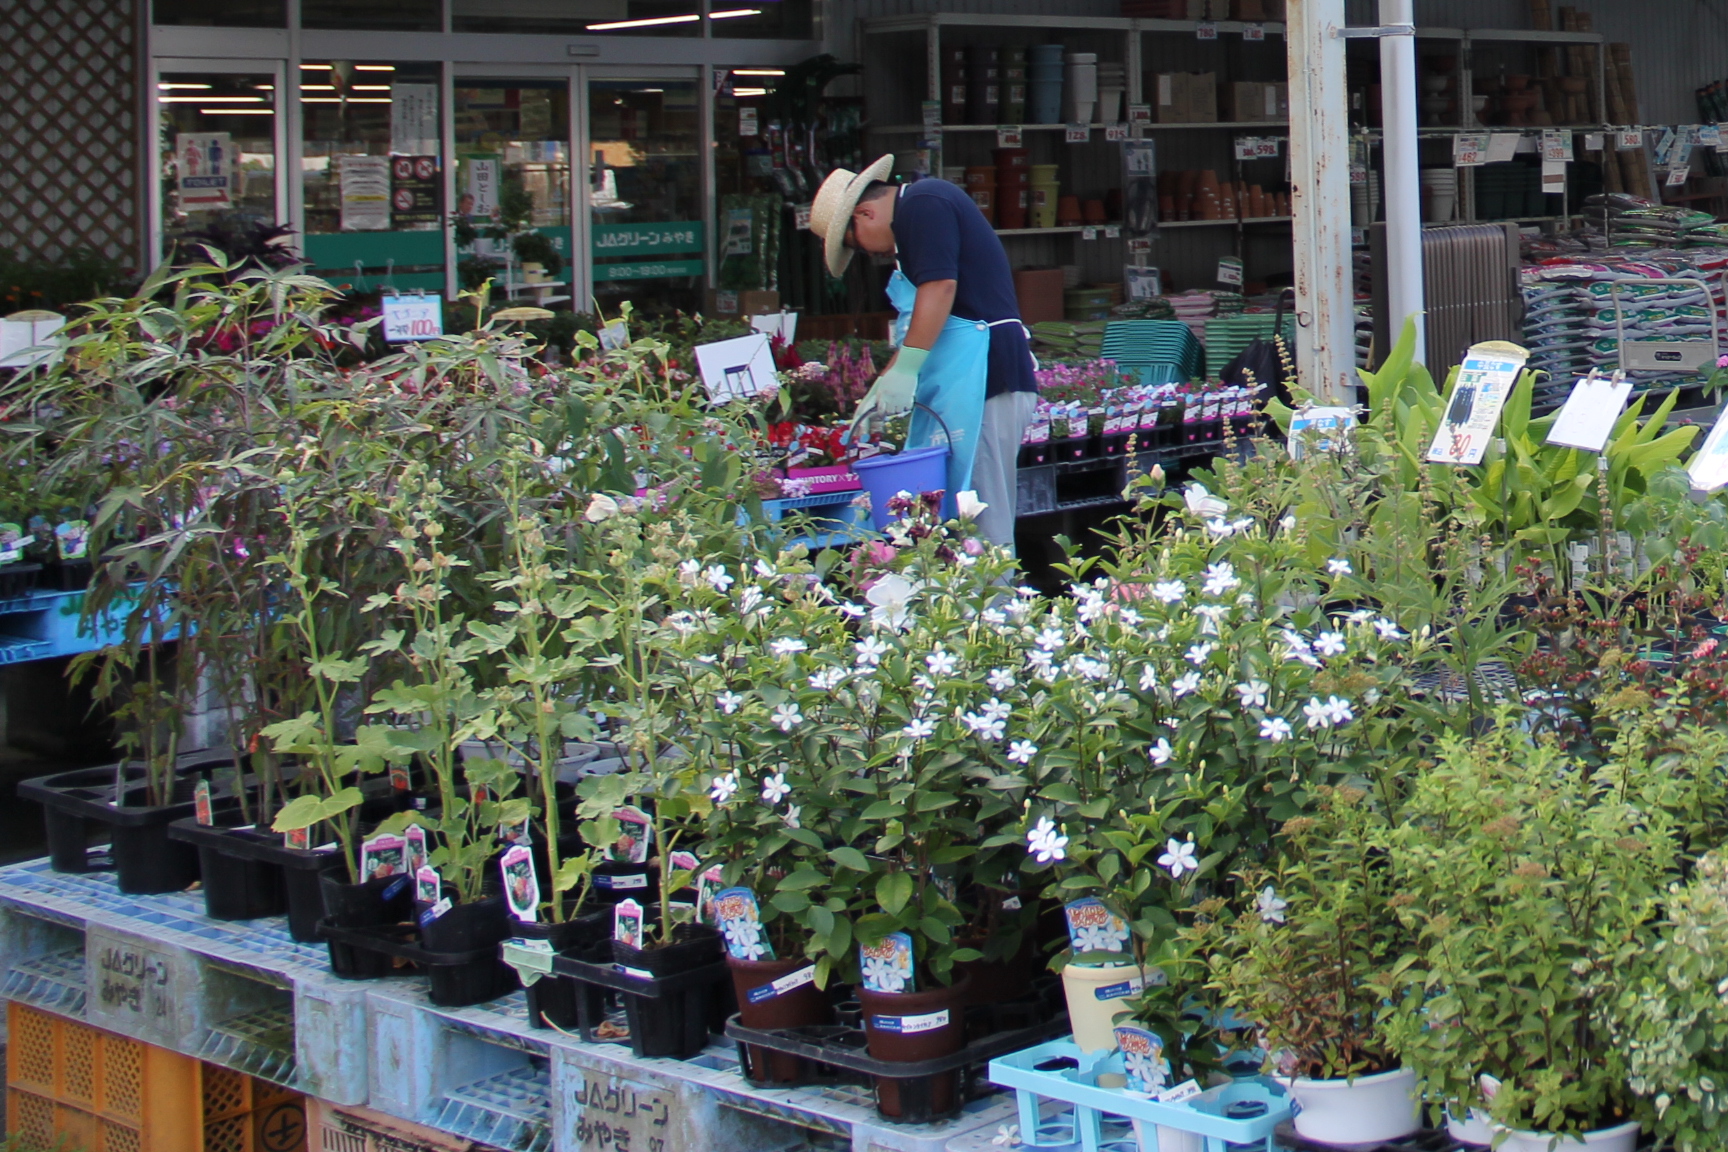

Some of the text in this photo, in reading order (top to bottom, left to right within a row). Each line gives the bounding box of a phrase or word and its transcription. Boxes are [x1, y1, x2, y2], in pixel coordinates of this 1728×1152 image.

[185, 177, 227, 187] TOILET
[101, 948, 168, 986] JAグリーン
[102, 979, 142, 1012] みやき
[574, 1079, 669, 1126] JAグリーン
